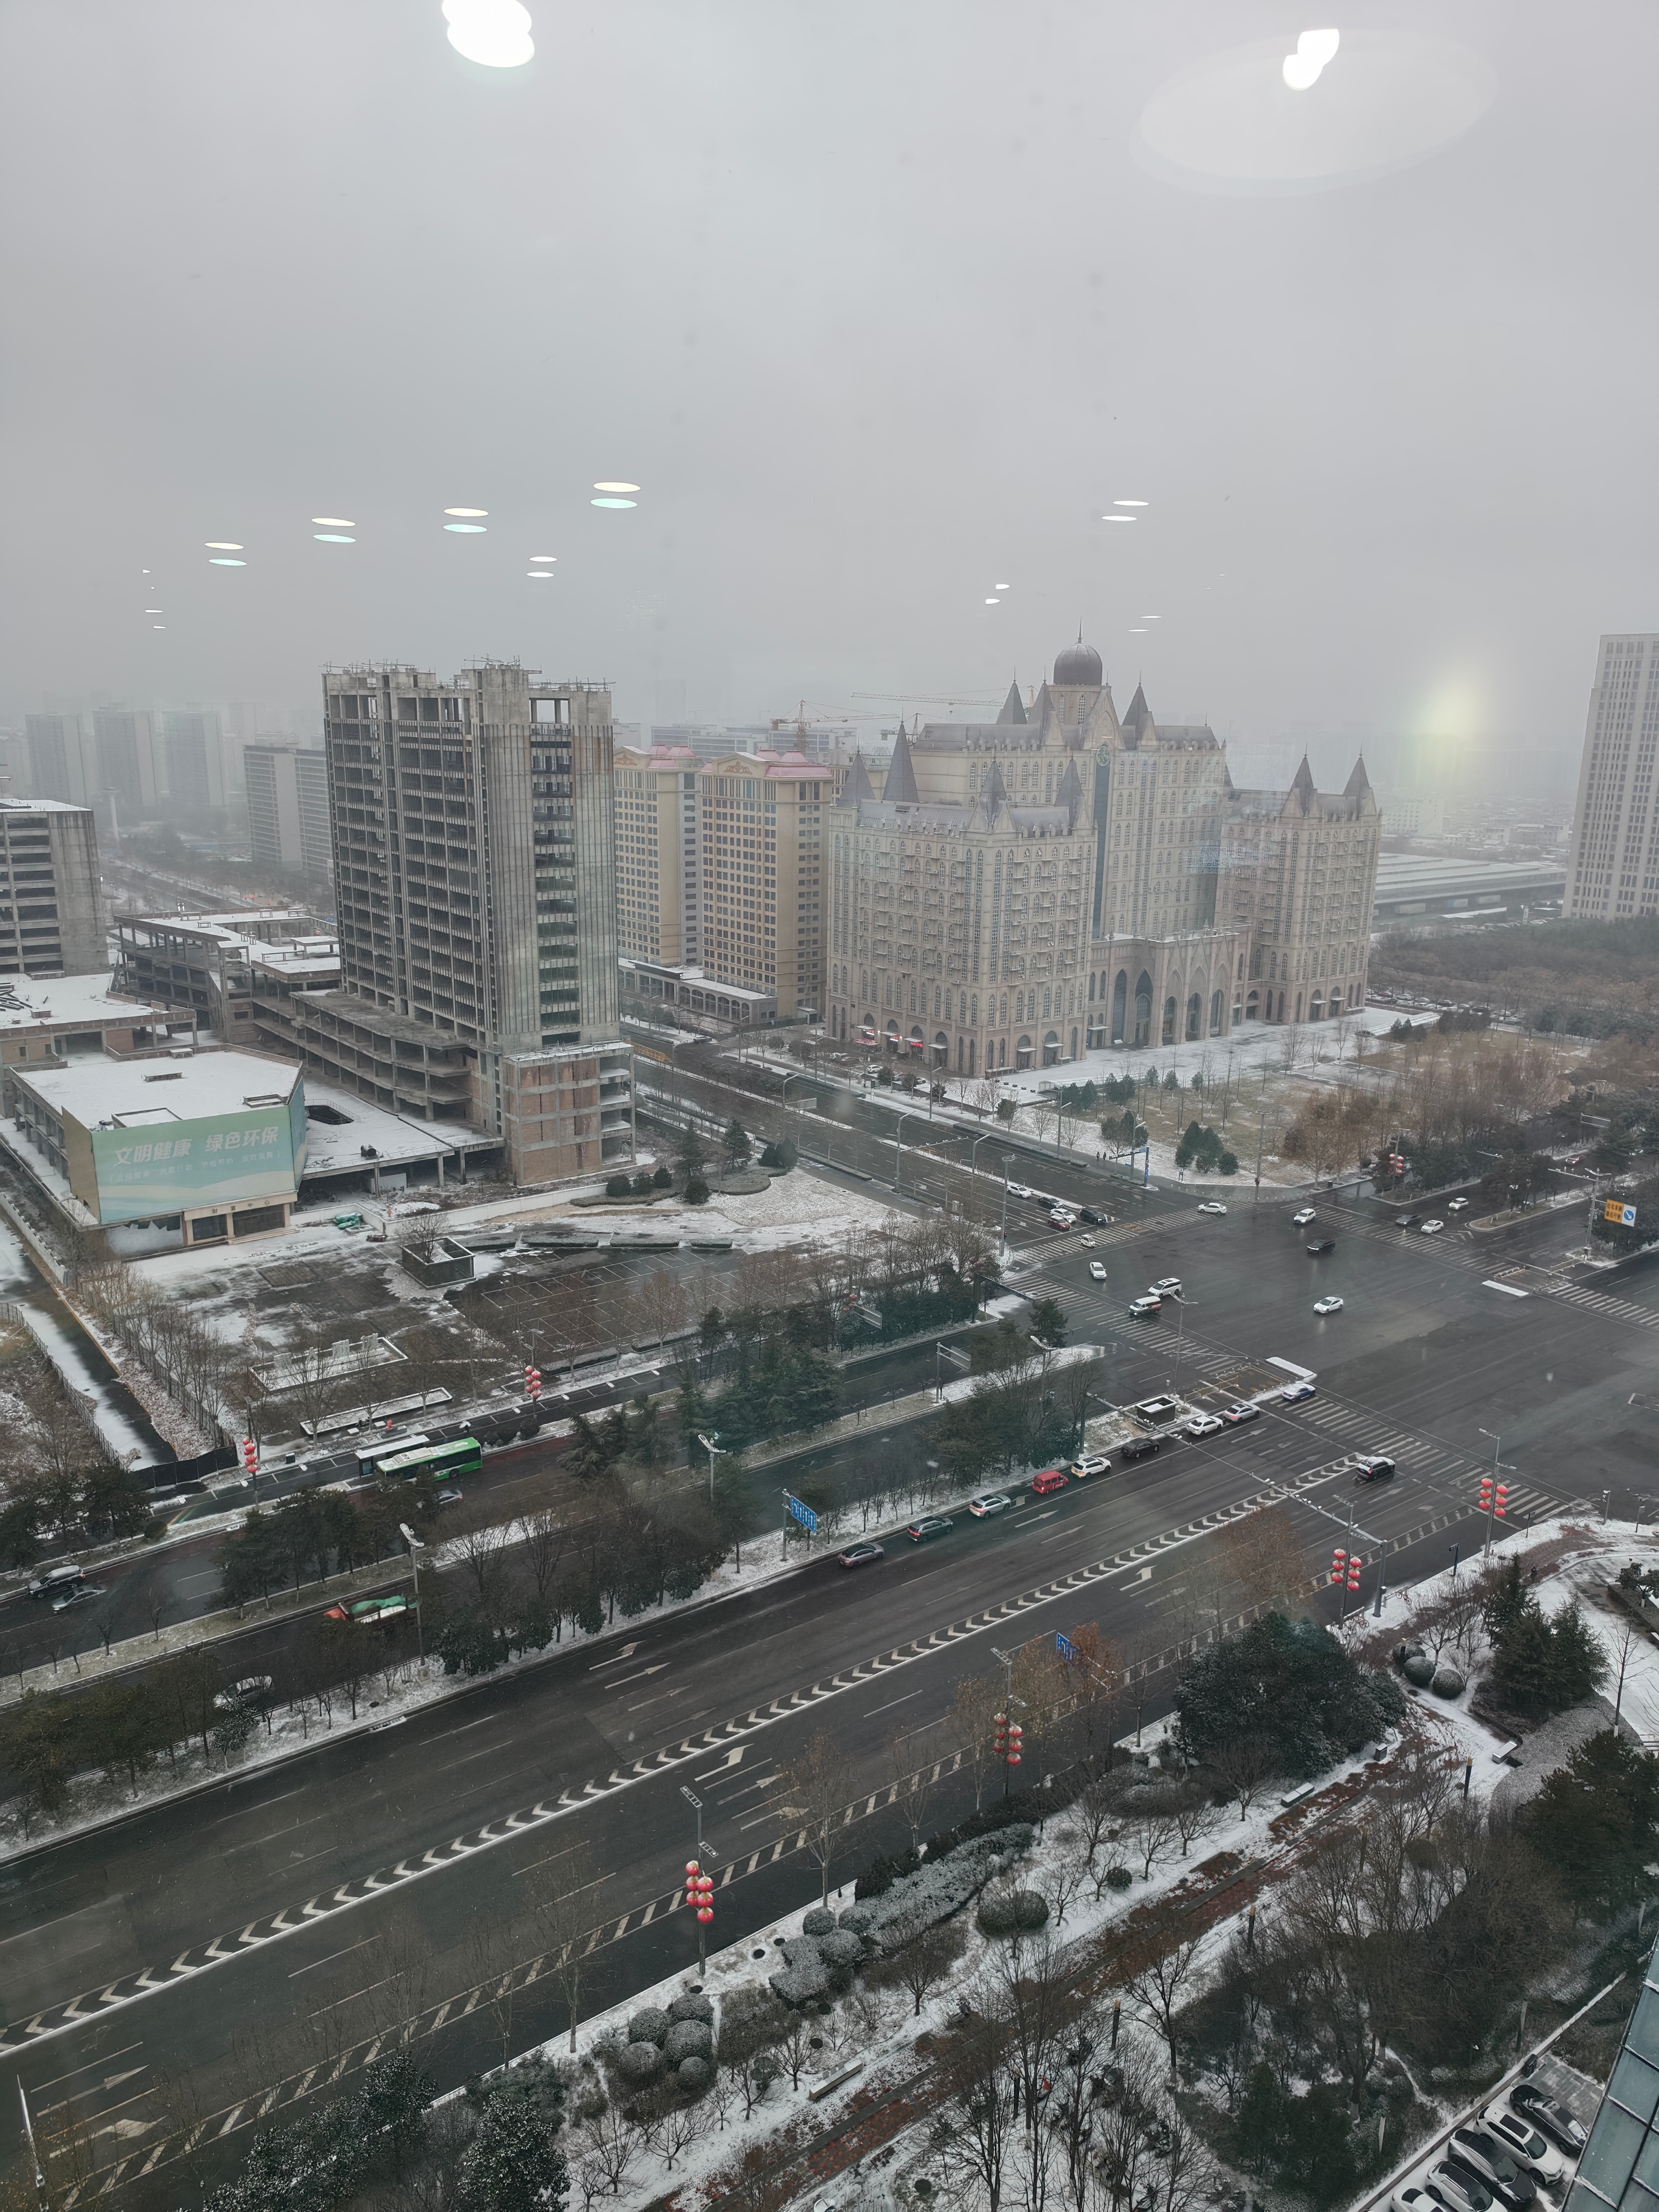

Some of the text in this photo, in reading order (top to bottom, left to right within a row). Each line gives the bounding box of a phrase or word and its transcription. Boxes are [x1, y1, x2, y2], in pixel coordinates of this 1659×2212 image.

[113, 1125, 279, 1168] 文明健康 绿色环保
